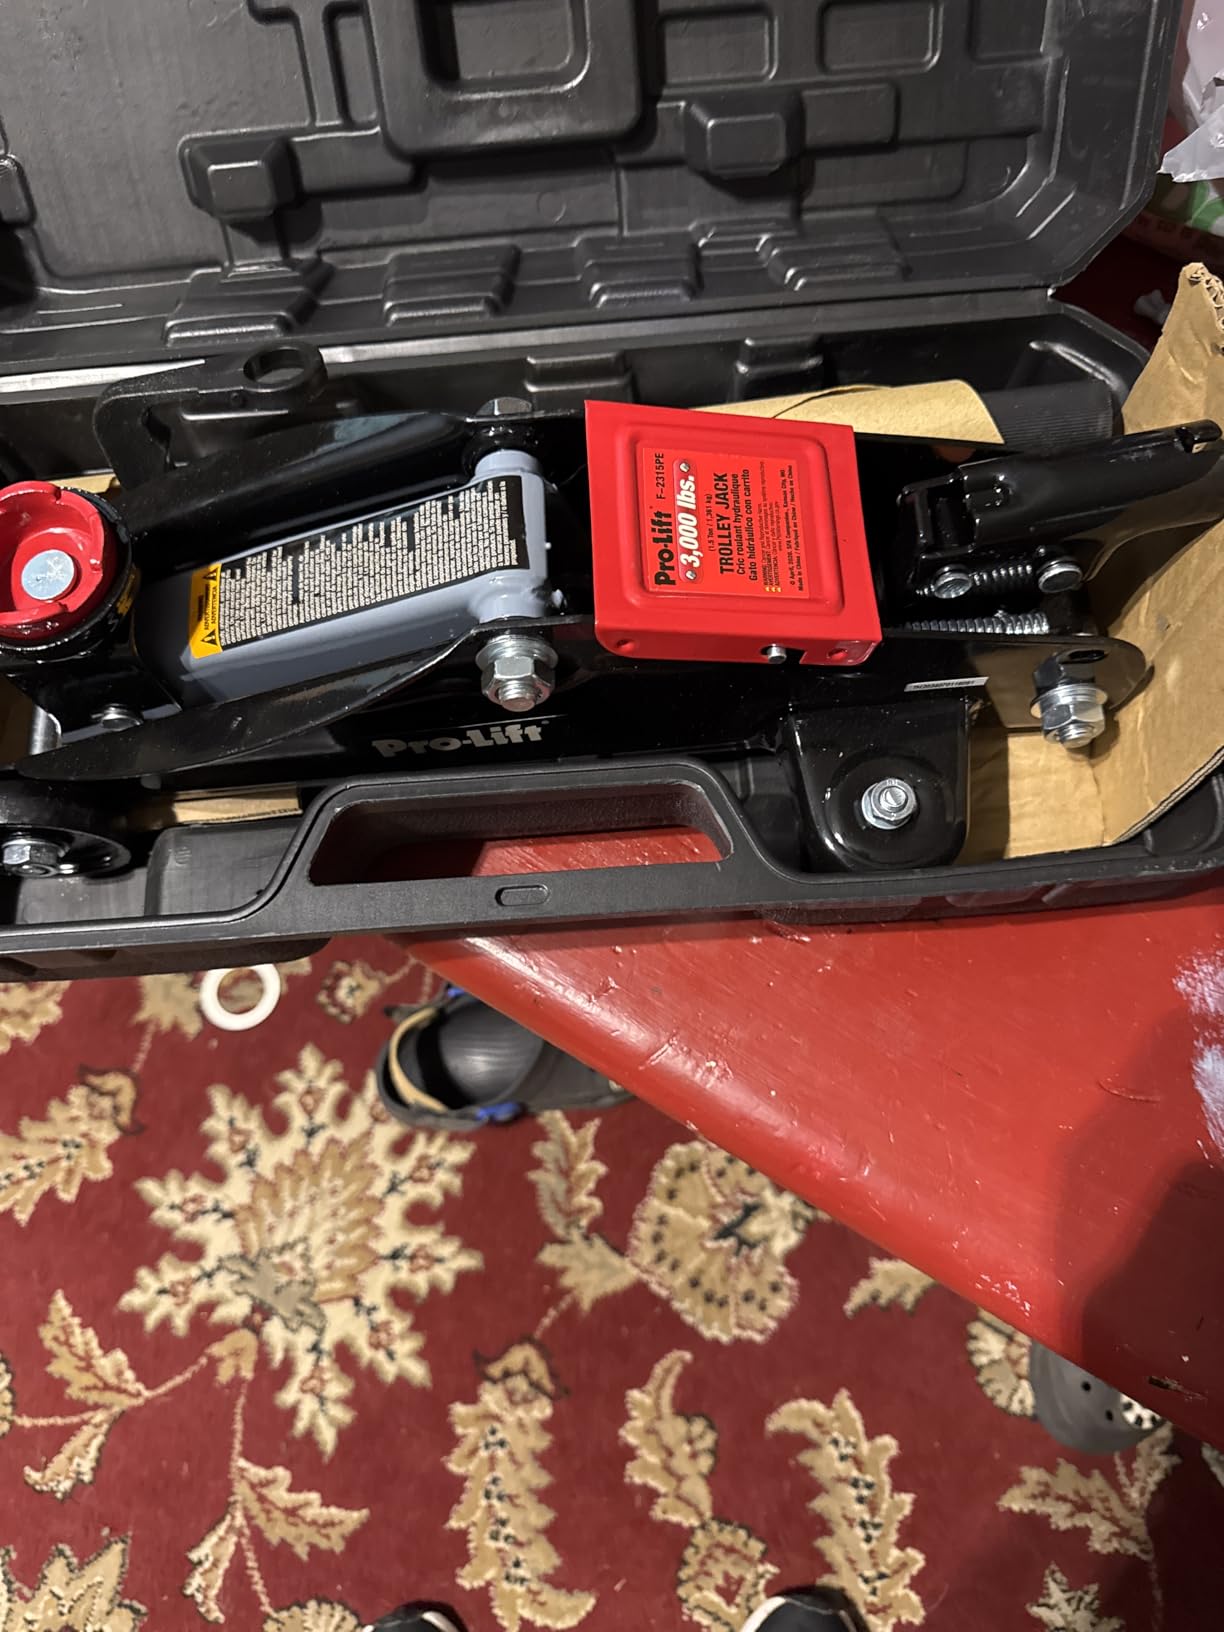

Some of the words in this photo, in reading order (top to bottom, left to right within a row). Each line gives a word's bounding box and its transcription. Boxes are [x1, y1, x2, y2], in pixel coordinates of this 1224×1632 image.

[654, 453, 666, 499] F-2315PE
[675, 474, 696, 509] lbs.
[713, 472, 730, 509] JACK
[742, 469, 751, 496] carrito
[730, 474, 743, 523] hydraulique
[744, 500, 752, 514] con
[651, 511, 676, 586] Pro-Lift
[677, 513, 704, 568] 3,000
[716, 514, 734, 574] TROLLEY
[734, 525, 744, 555] roulant
[745, 517, 756, 559] hidráulico
[736, 558, 745, 574] Cric
[748, 562, 757, 580] Gato
[372, 724, 542, 758] Pro-Lift
